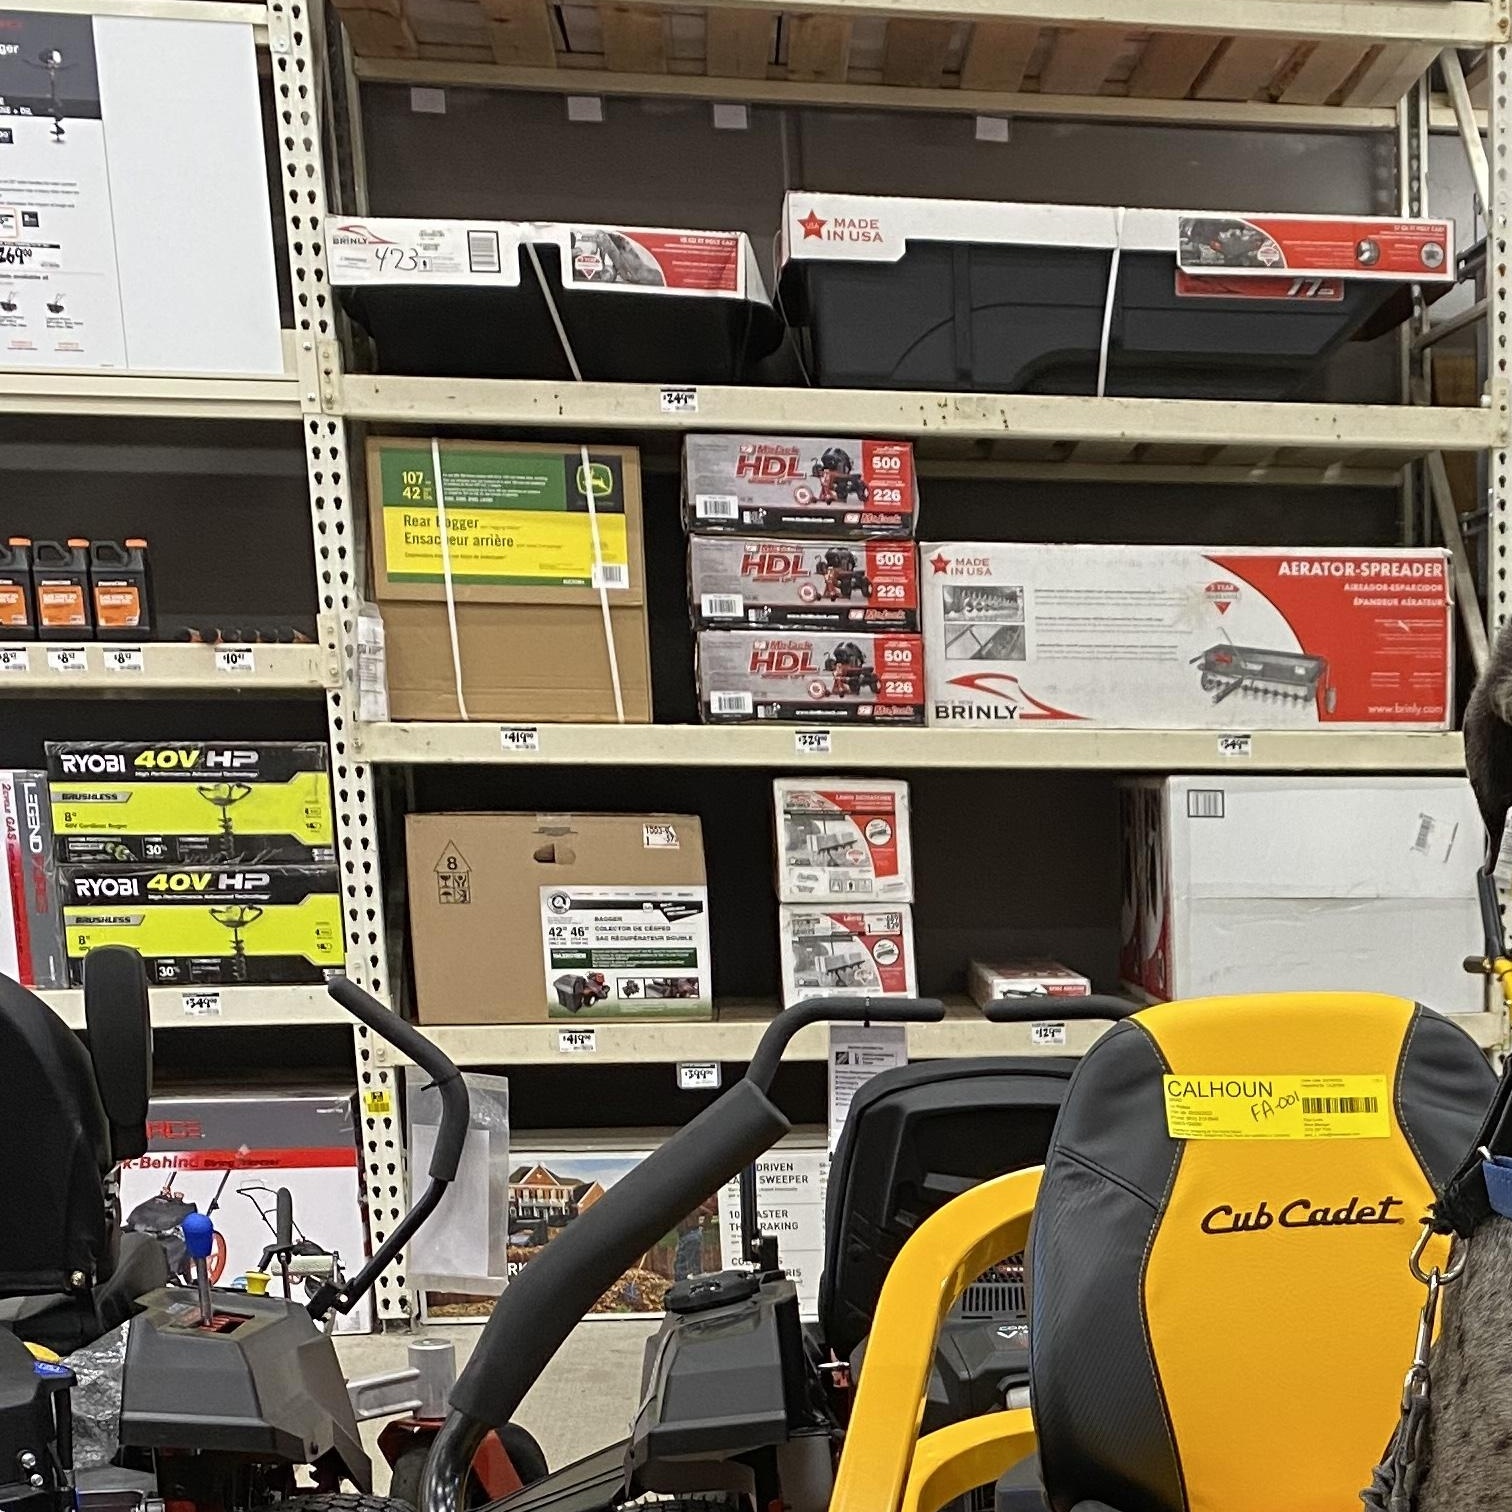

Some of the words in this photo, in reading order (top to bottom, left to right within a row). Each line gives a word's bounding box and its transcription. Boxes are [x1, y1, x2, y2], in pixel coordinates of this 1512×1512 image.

[834, 218, 879, 230] MADE
[332, 237, 368, 246] BRINLY
[827, 230, 845, 241] IN
[848, 230, 883, 243] USA
[736, 455, 806, 479] HDL
[872, 457, 901, 469] 500
[402, 470, 424, 486] 107
[402, 487, 422, 501] 42
[873, 489, 901, 502] 226
[403, 513, 431, 528] Rear
[403, 532, 470, 548] Ensaceur
[472, 534, 514, 549] arrière
[740, 554, 810, 578] HDL
[875, 553, 904, 566] 500
[955, 558, 990, 567] MADE
[950, 566, 965, 576] IN
[966, 566, 993, 577] USA
[1278, 560, 1443, 579] AERATOR-SPREADER
[877, 585, 905, 599] 226
[748, 650, 819, 675] HDL
[884, 651, 912, 663] 500
[886, 681, 914, 694] 226
[935, 703, 1019, 721] BRINLY
[1366, 703, 1444, 717] www.brinly.com
[60, 753, 126, 773] RYOBI
[133, 749, 200, 768] 40V
[205, 749, 260, 768] HP
[22, 781, 44, 855] LEGEND
[6, 816, 17, 841] GAS
[447, 856, 457, 871] 8
[74, 877, 140, 898] RYOBI
[146, 872, 213, 891] 40V
[217, 872, 271, 890] HP
[1167, 1080, 1274, 1099] CALHOUN
[1250, 1091, 1301, 1123] FA-001
[756, 1163, 794, 1172] DRIVEN
[759, 1174, 809, 1184] SWEEPER
[757, 1209, 789, 1219] ASTER
[1201, 1202, 1274, 1234] Cub
[1278, 1196, 1403, 1228] Cadet
[760, 1222, 799, 1231] RAKING
